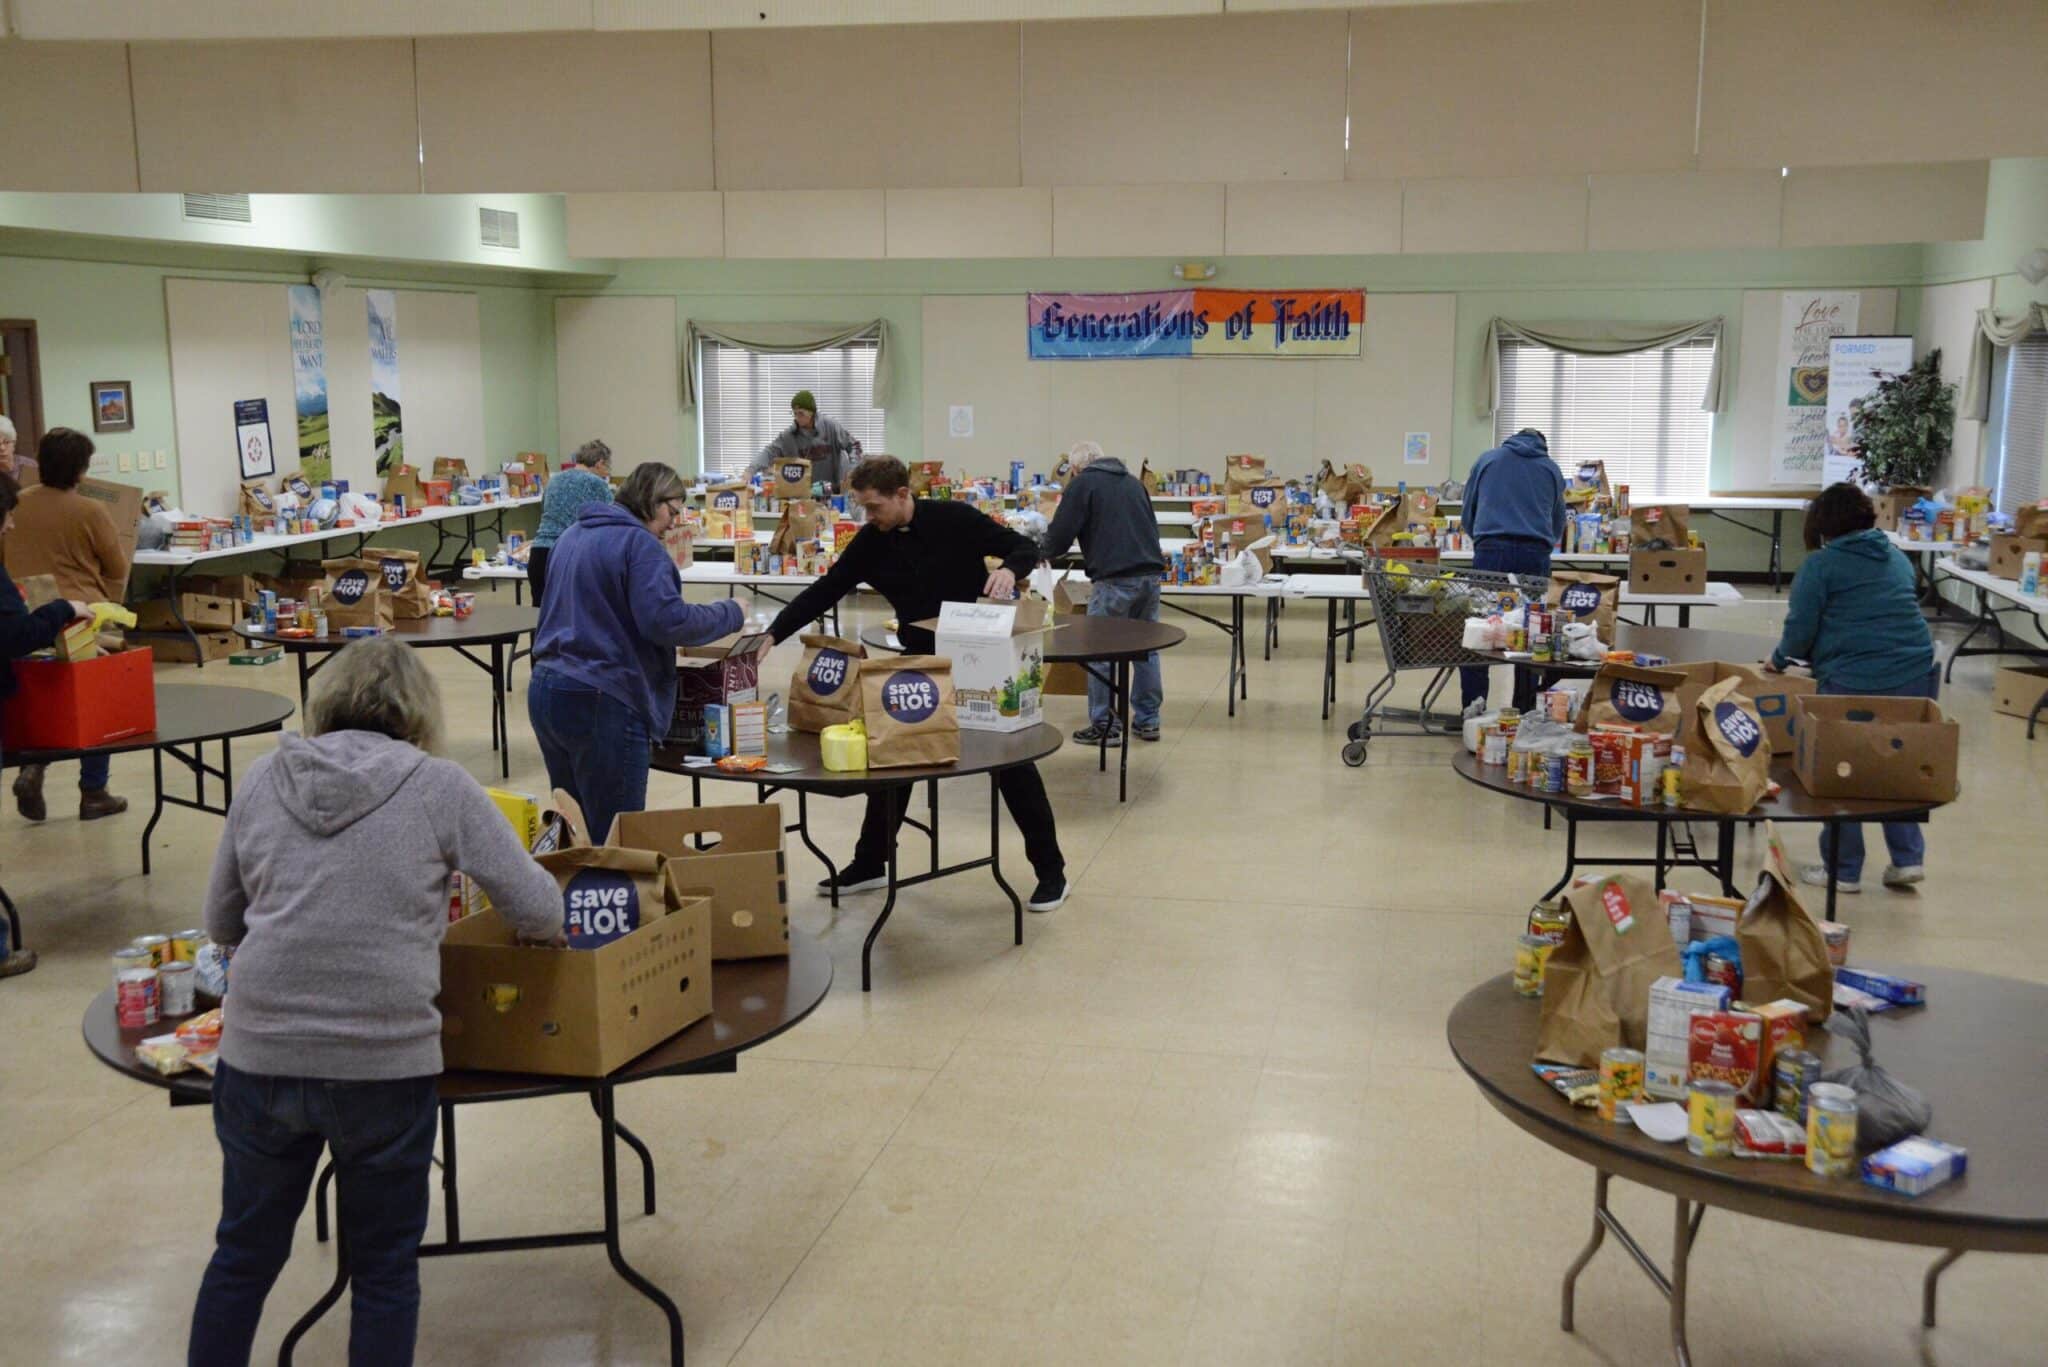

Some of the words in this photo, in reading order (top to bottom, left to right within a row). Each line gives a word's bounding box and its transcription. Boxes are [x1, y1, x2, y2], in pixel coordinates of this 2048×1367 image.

[1042, 300, 1209, 342] Generations
[1225, 300, 1257, 340] of
[1272, 299, 1350, 349] Faith
[384, 565, 403, 573] ave
[1567, 590, 1597, 599] save
[816, 656, 845, 671] save
[889, 682, 931, 695] save
[1720, 710, 1747, 734] save
[570, 887, 629, 909] save
[569, 910, 581, 925] a
